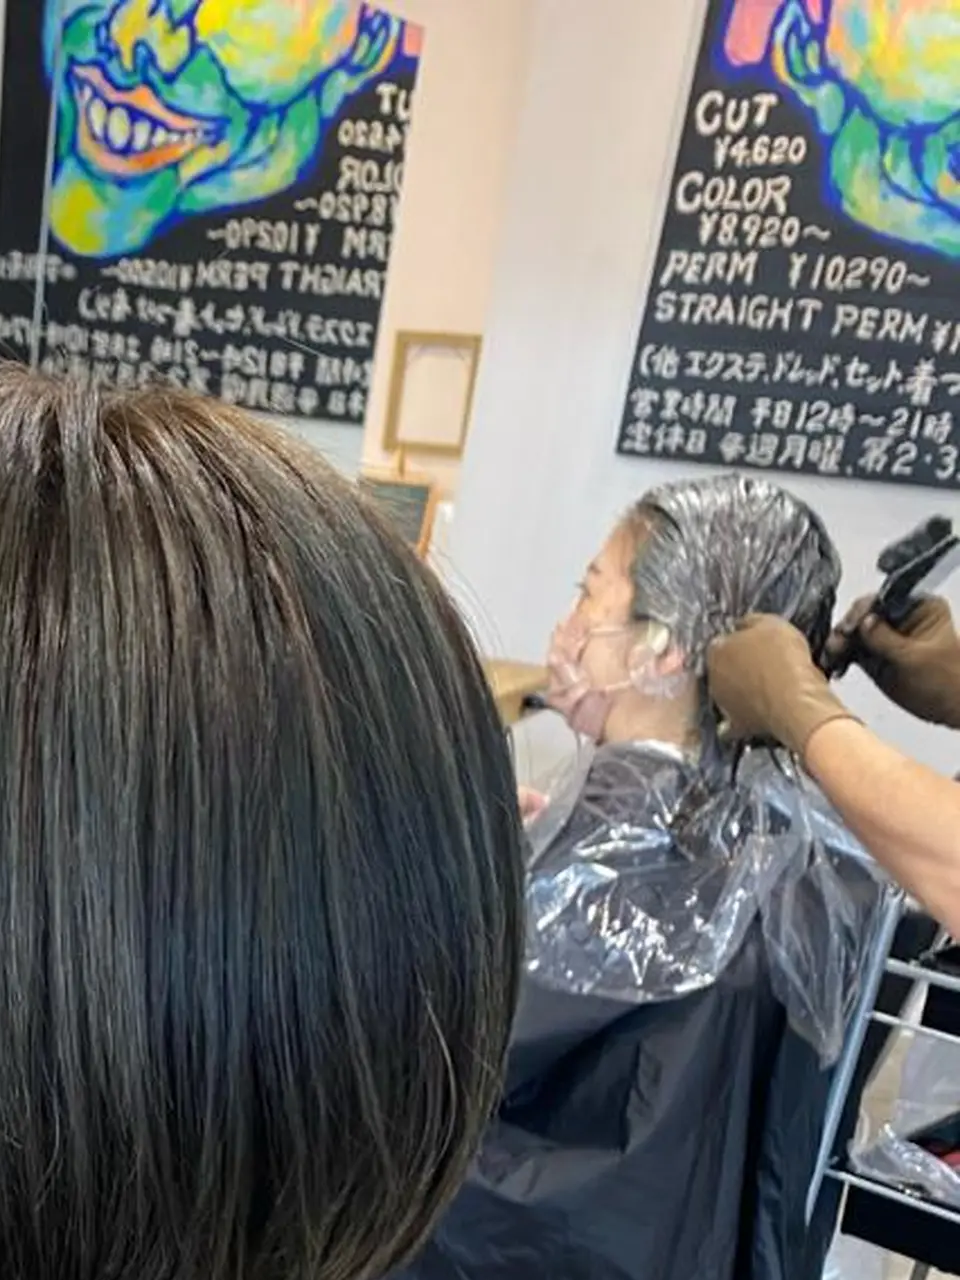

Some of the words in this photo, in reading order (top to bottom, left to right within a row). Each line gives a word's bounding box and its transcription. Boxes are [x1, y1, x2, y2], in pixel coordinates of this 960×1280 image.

[695, 90, 779, 136] CUT
[675, 171, 792, 214] COLOR
[658, 250, 759, 287] PERM
[654, 292, 824, 333] STRAIGHT
[830, 302, 928, 345] PERM
